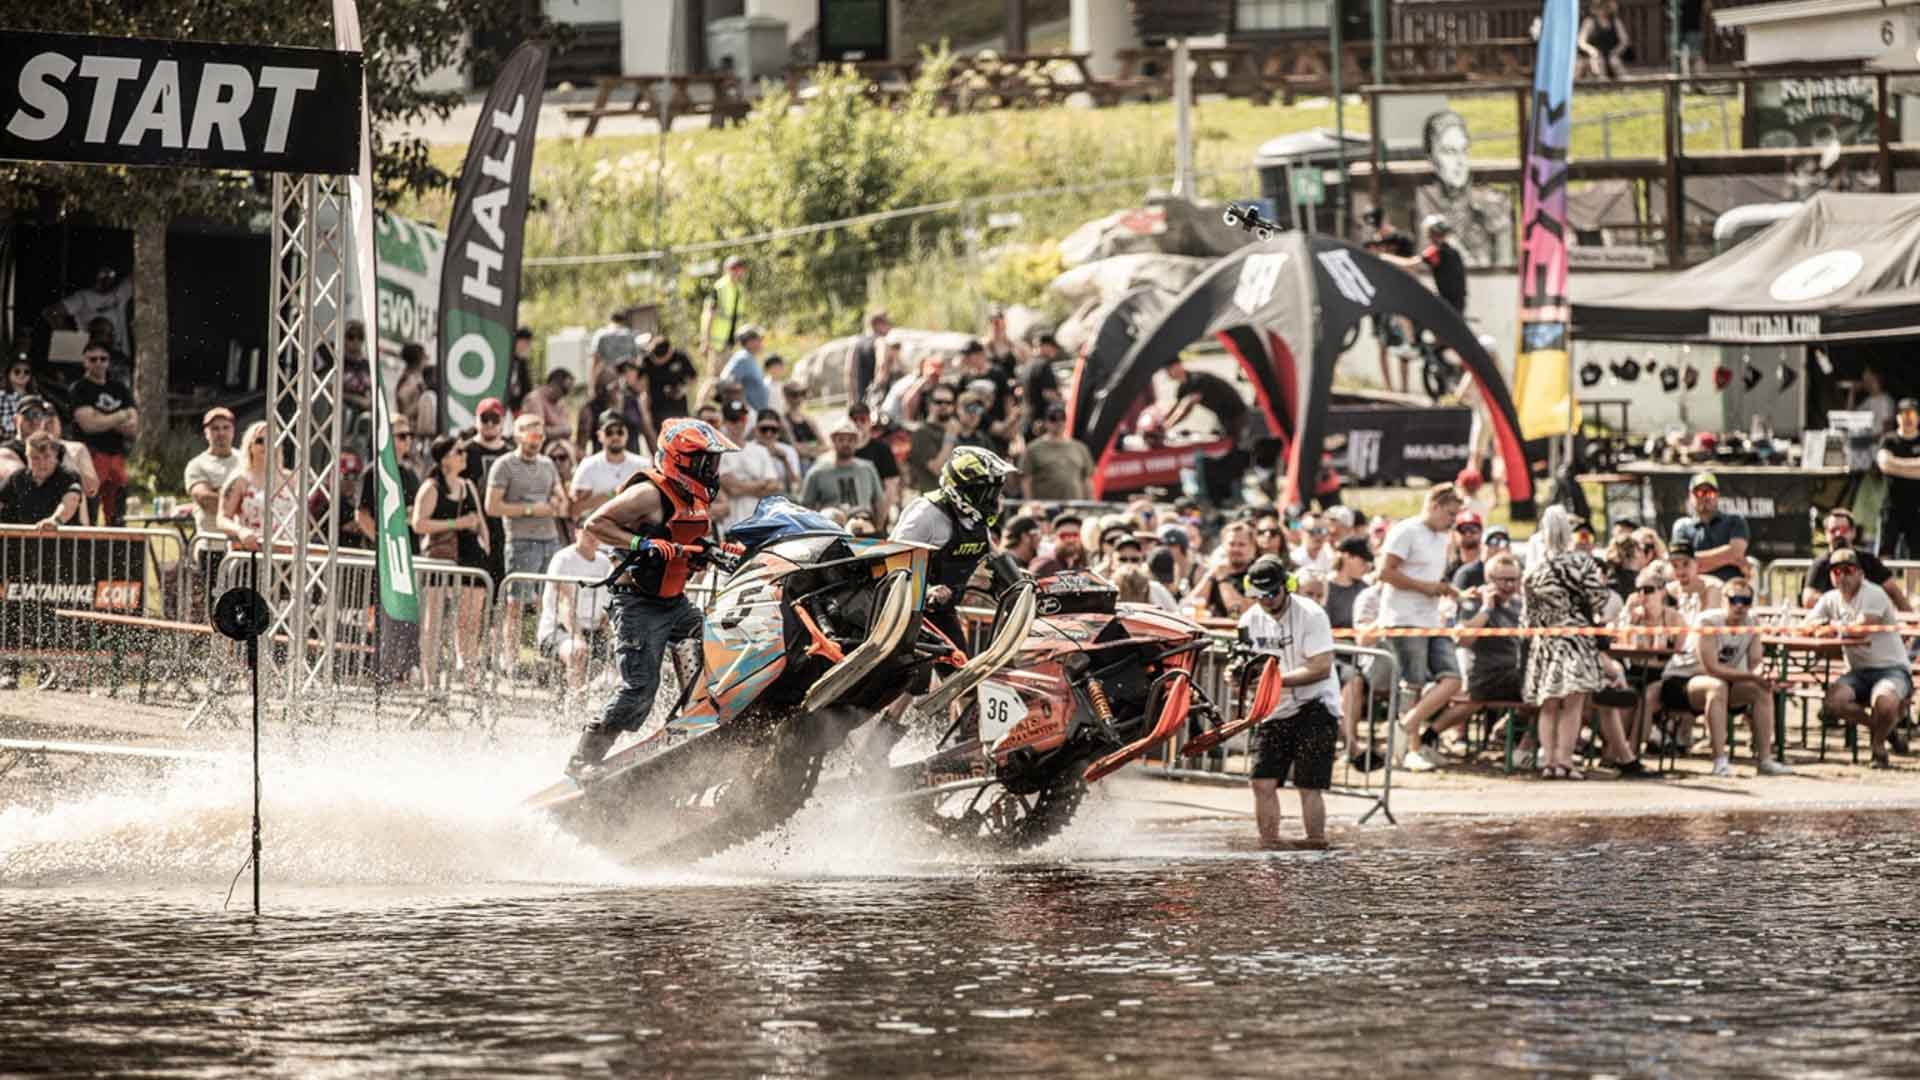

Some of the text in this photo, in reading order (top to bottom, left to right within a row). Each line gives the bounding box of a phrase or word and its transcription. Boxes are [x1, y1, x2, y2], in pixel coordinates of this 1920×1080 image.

[1881, 19, 1895, 47] 6
[5, 51, 320, 153] START
[461, 94, 525, 306] HALL
[986, 697, 1009, 723] 36
